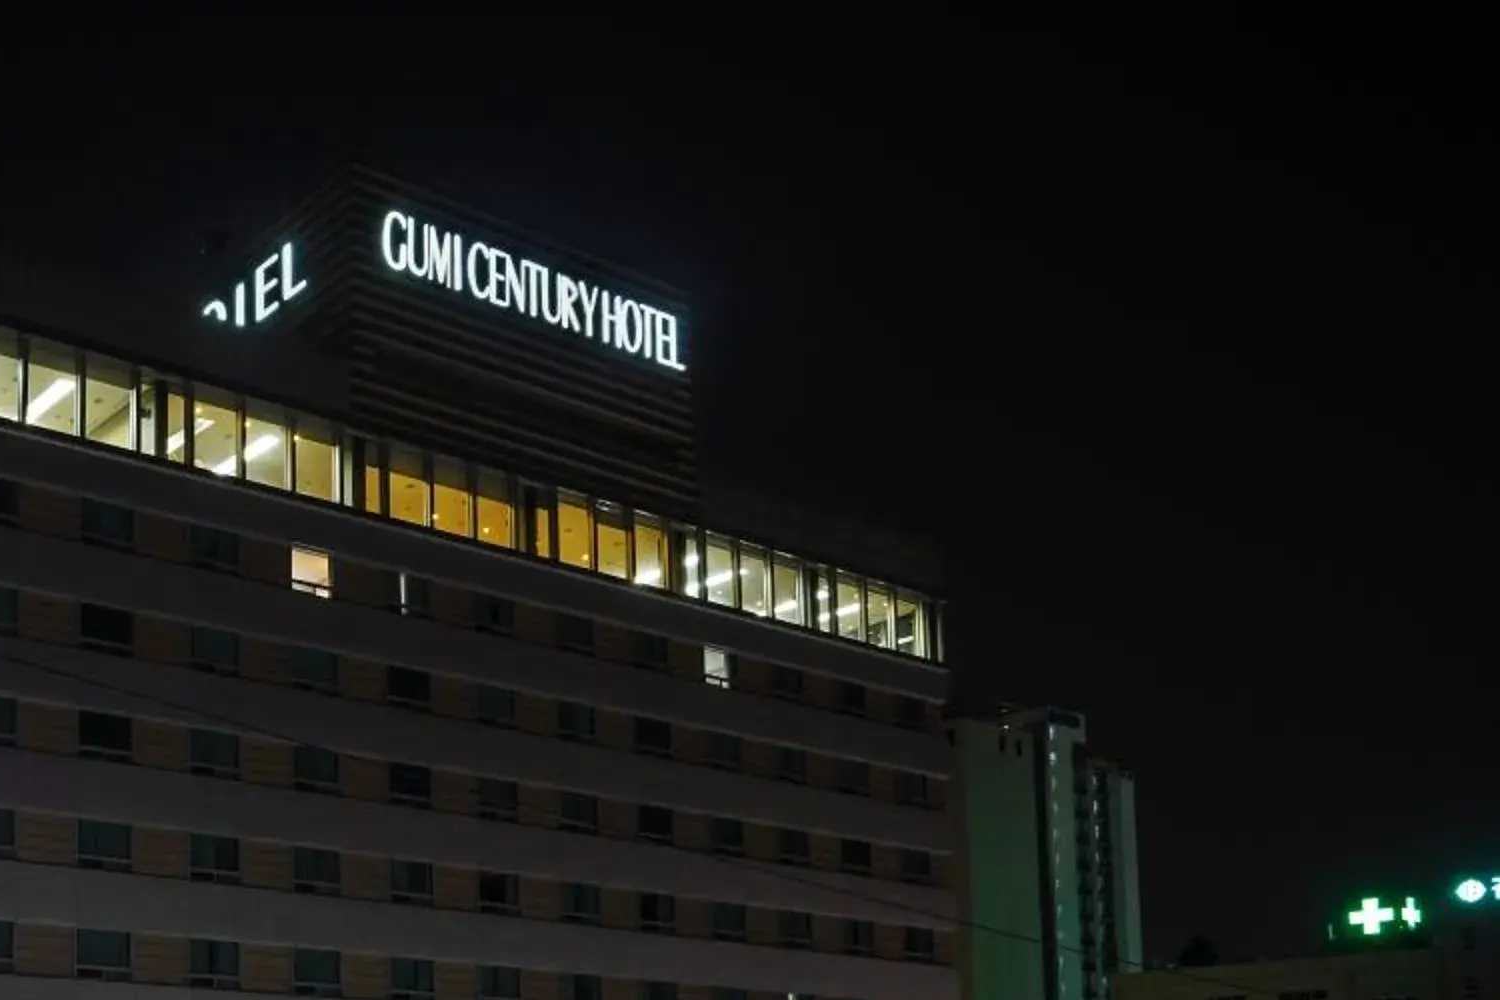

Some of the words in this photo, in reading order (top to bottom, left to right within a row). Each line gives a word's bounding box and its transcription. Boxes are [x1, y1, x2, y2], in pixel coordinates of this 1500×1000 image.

[382, 211, 462, 291] GUMI
[468, 242, 599, 338] CENTURY
[601, 289, 686, 371] HOTEL
